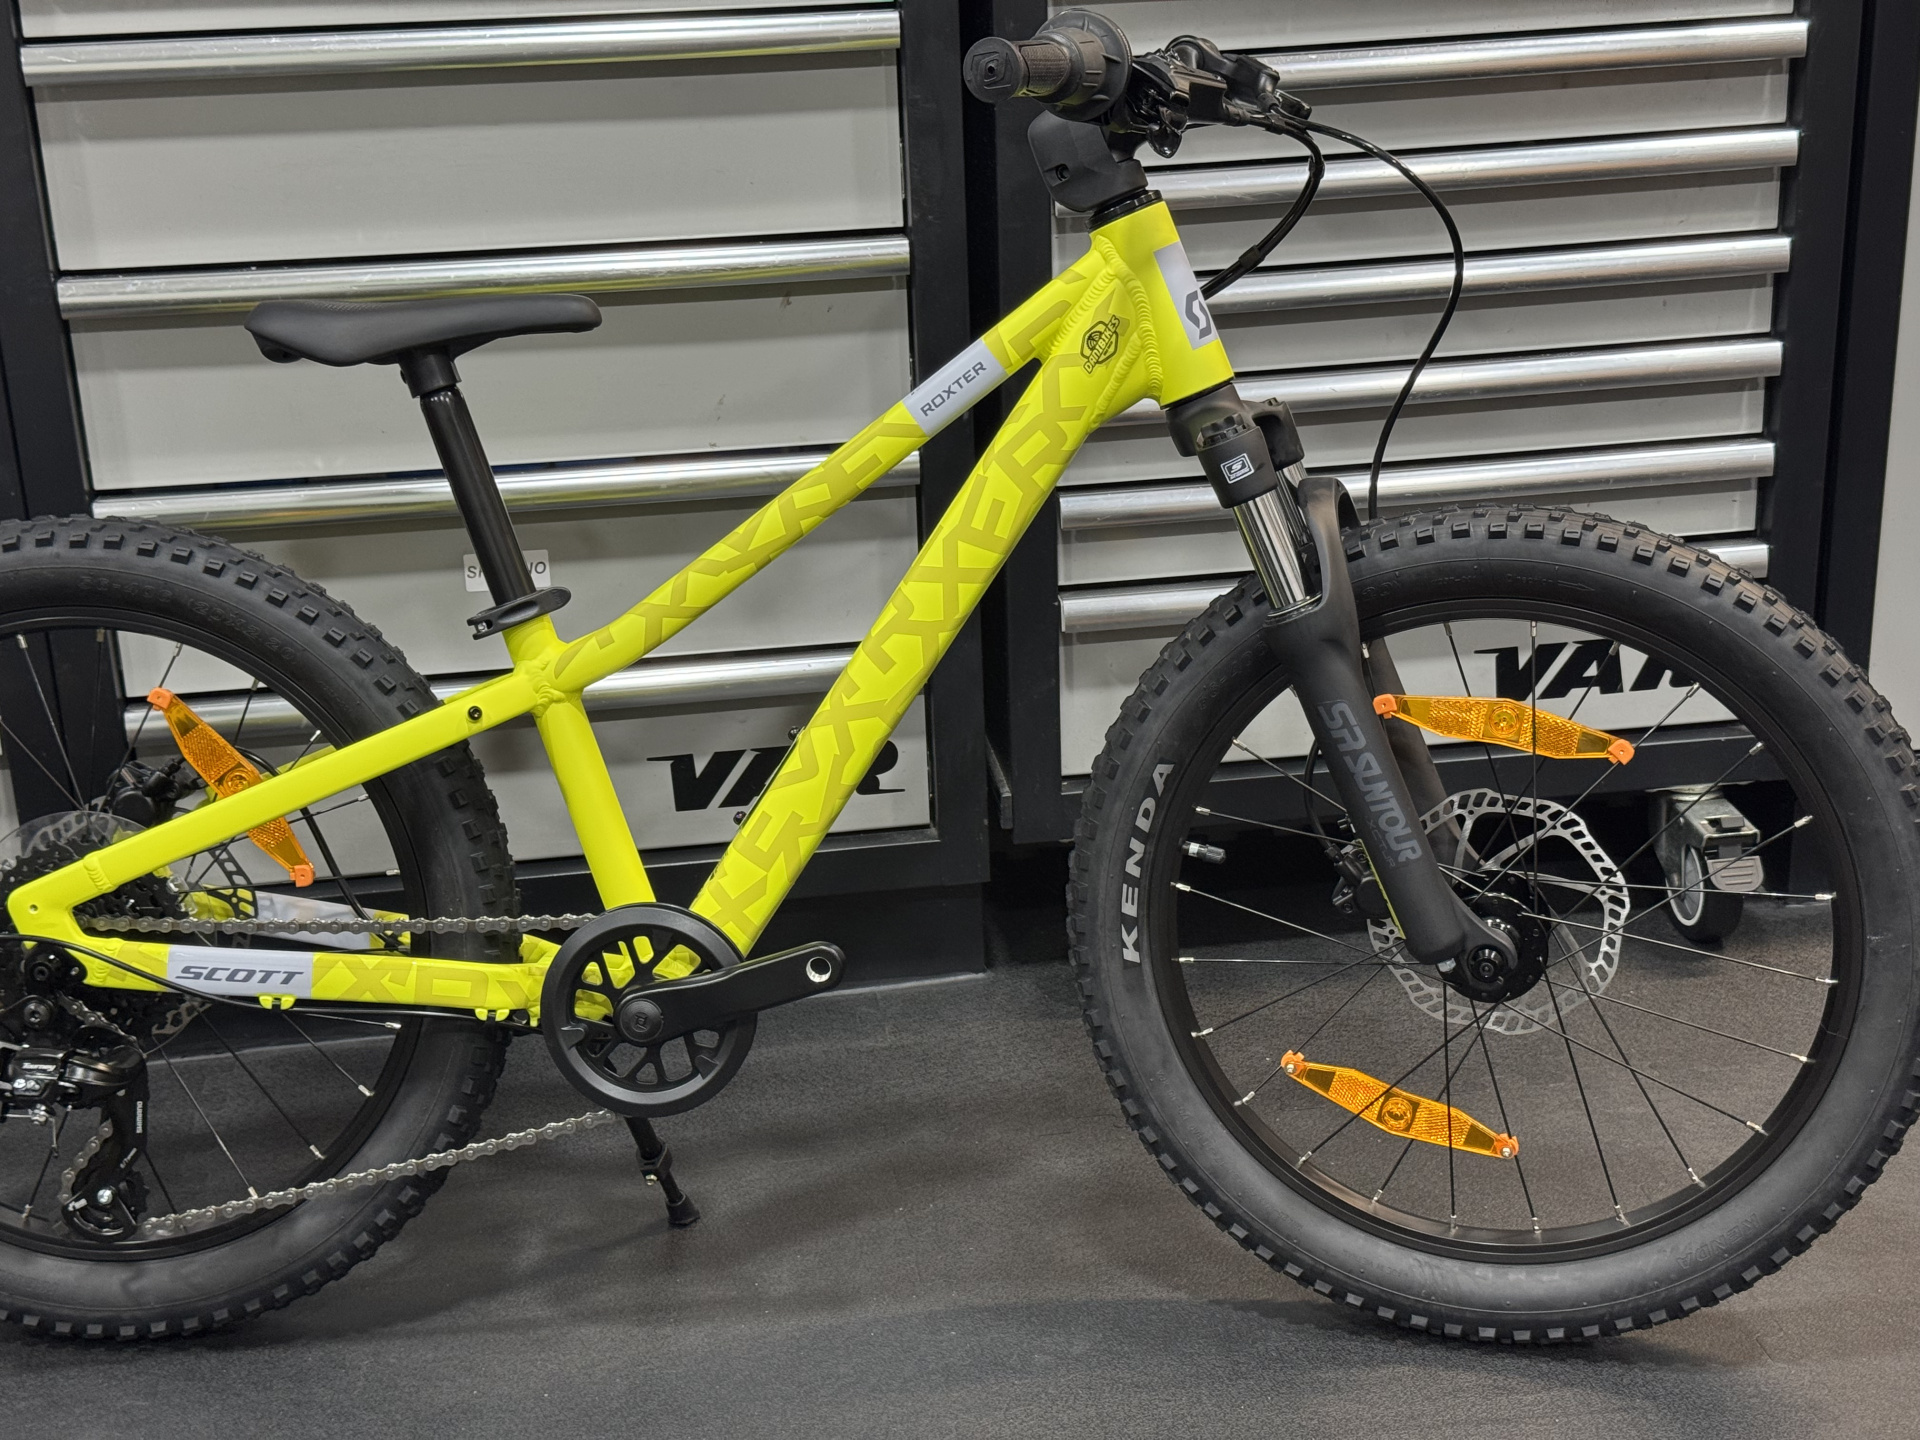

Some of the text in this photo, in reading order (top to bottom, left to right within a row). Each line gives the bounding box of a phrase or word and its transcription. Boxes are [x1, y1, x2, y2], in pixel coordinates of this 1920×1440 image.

[1084, 316, 1119, 373] DANIBIKES
[920, 361, 987, 417] ROXTER
[1317, 700, 1423, 862] SR SUNTOUR
[1121, 763, 1175, 963] KENDA
[175, 965, 304, 985] SCOTT
